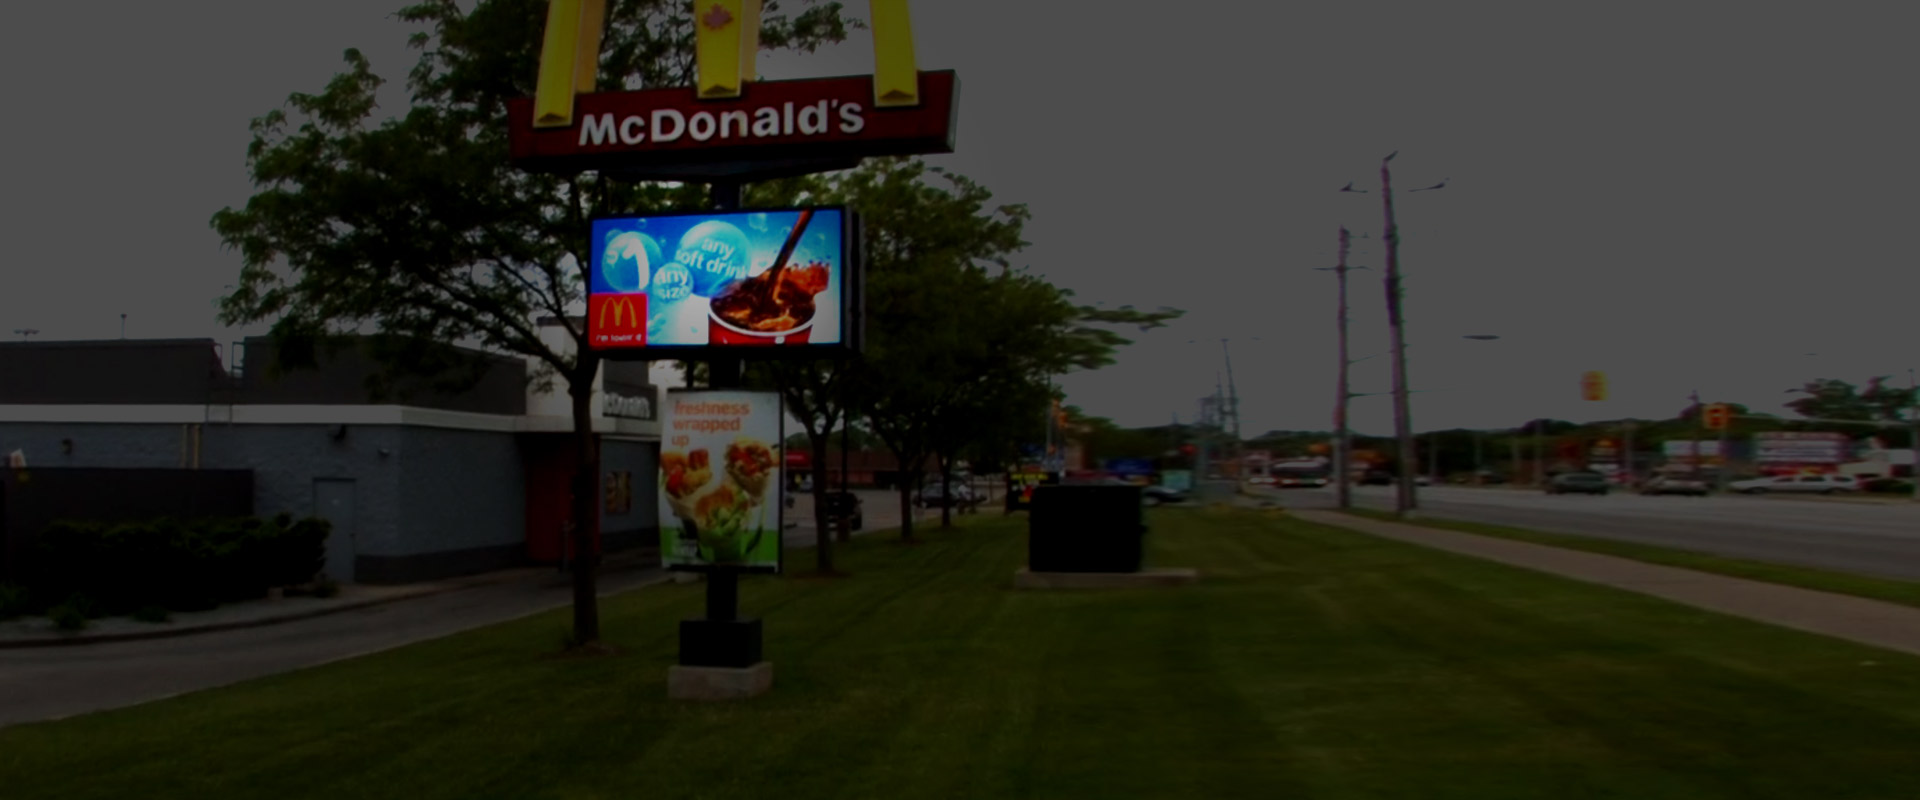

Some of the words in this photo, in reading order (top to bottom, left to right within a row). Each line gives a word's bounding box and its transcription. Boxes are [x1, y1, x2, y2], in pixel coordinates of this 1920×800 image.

[578, 98, 865, 147] McDonald's
[701, 238, 735, 260] any
[675, 400, 750, 415] freshness
[673, 417, 741, 433] wrapped
[672, 436, 689, 448] up
